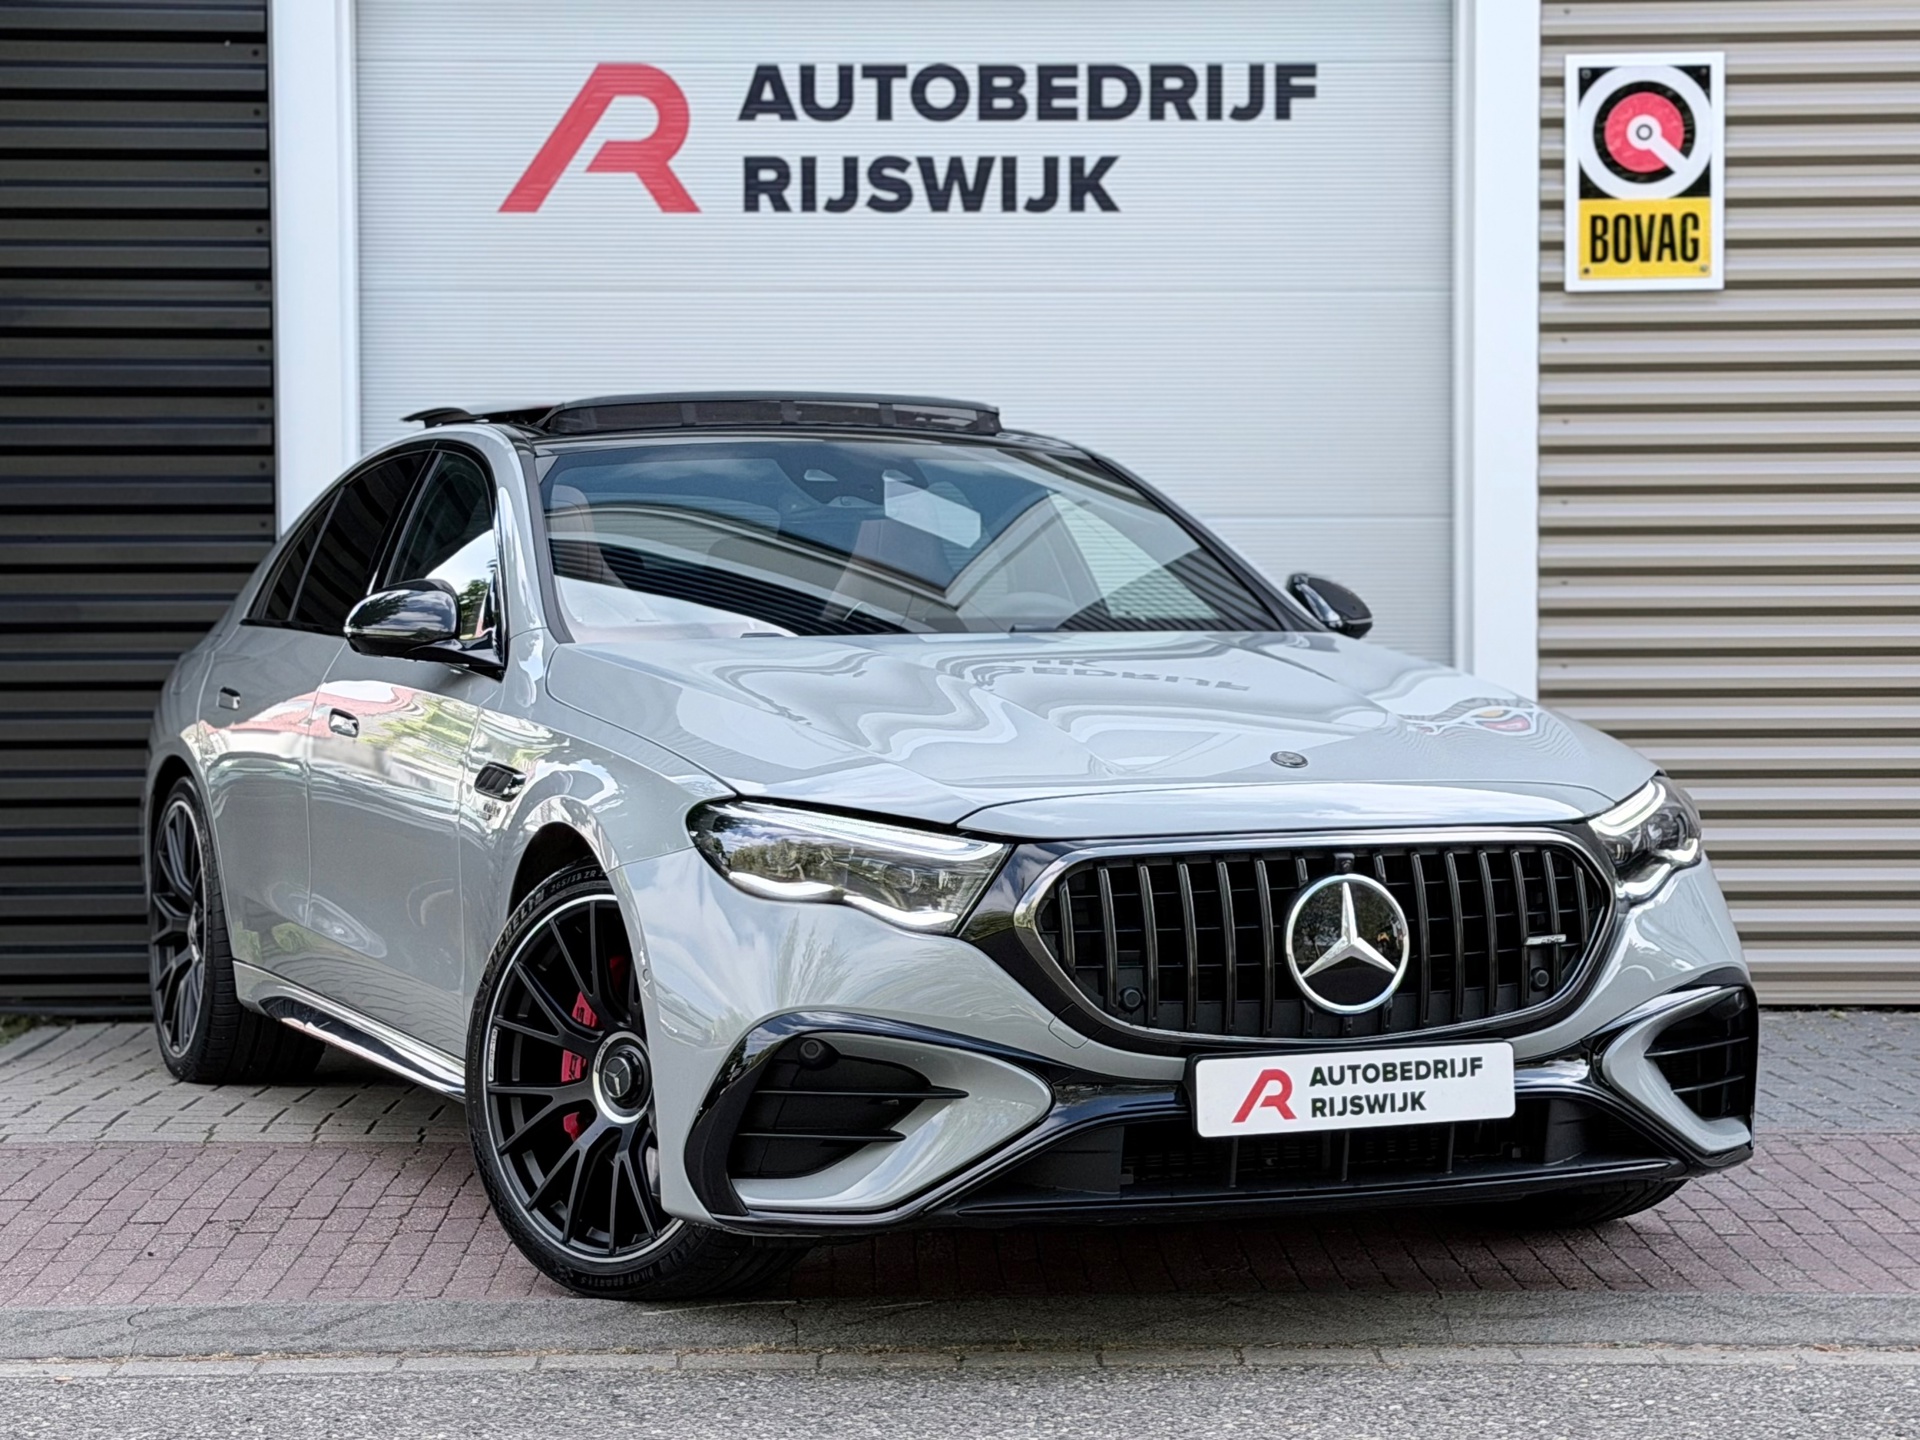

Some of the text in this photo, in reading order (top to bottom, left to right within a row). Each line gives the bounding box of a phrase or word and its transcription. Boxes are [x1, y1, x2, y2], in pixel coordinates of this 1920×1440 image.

[738, 63, 1317, 122] AUTOBEDRIJF
[743, 155, 1119, 213] RIJSWIJK
[1589, 212, 1700, 264] BOVAG
[1309, 1056, 1483, 1088] AUTOBEDRIJF
[1311, 1091, 1427, 1118] RIJSWIJK
